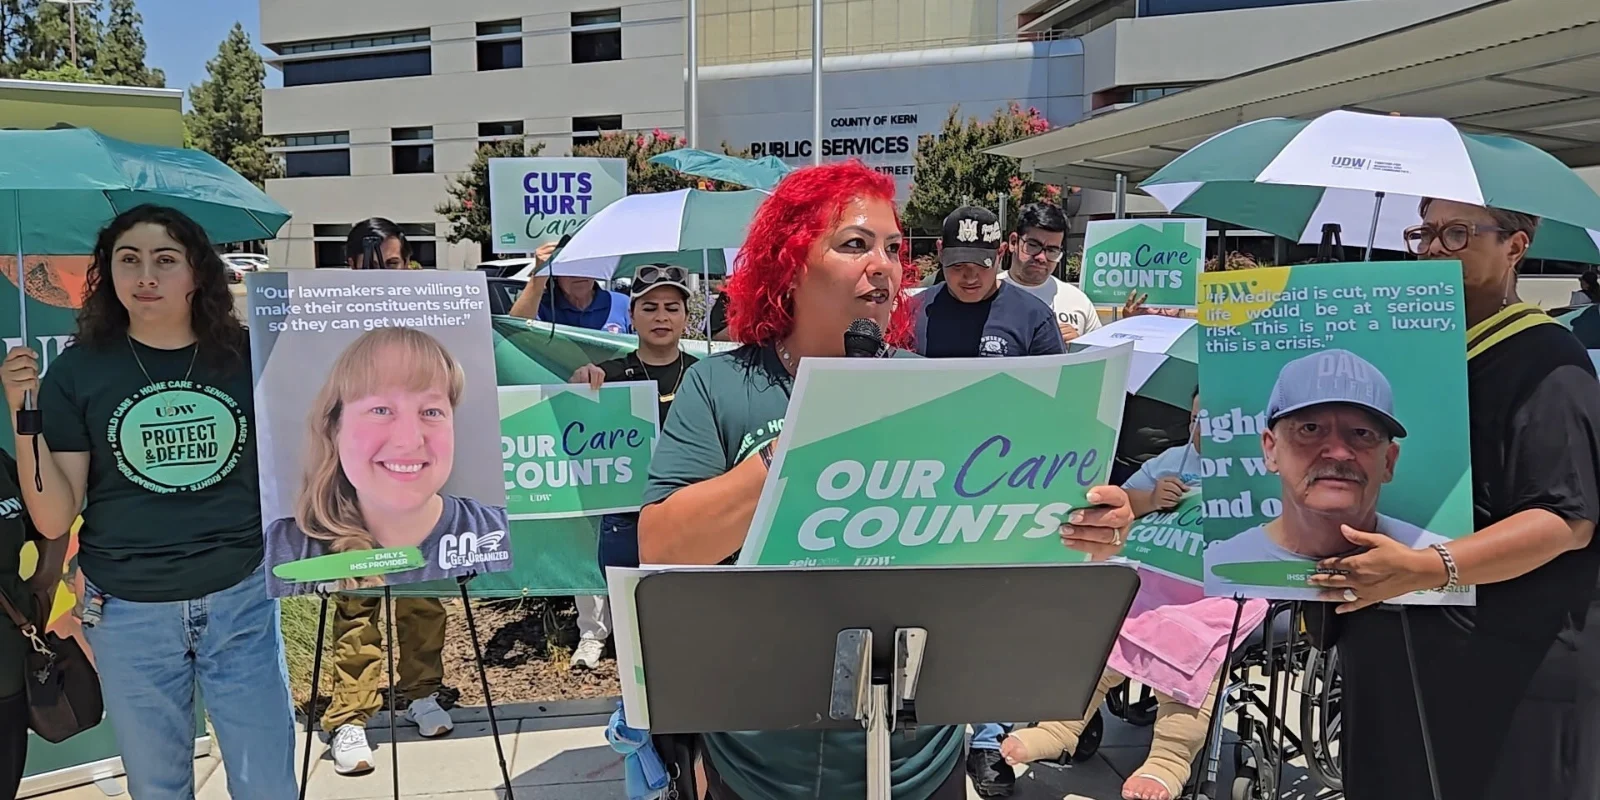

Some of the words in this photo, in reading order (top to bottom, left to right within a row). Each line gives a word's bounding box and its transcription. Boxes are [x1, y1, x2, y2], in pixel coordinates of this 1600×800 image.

[831, 117, 871, 128] COUNTY
[874, 116, 887, 125] OF
[891, 114, 917, 124] KERN
[751, 140, 812, 159] PUBLIC
[822, 136, 909, 156] SERVICES
[874, 166, 915, 176] STREET
[1332, 156, 1366, 167] UDW
[523, 172, 592, 194] CUTS
[524, 195, 592, 215] HURT
[1094, 252, 1132, 267] OUR
[1136, 244, 1192, 267] Care
[1092, 269, 1182, 289] COUNTS
[256, 286, 295, 299] “Our
[298, 284, 384, 298] lawmakers
[388, 287, 411, 296] are
[414, 283, 462, 297] willing
[465, 284, 480, 295] to
[1230, 287, 1308, 304] Medicaid
[1314, 286, 1328, 299] is
[1332, 286, 1367, 300] cut,
[1372, 286, 1401, 299] my
[256, 302, 301, 316] make
[304, 301, 342, 314] their
[346, 299, 440, 312] constituents
[443, 298, 484, 310] suffer
[1206, 308, 1231, 321] life
[1246, 304, 1300, 318] would
[1316, 303, 1338, 315] be
[1354, 302, 1372, 314] at
[1388, 298, 1455, 313] serious
[269, 322, 288, 332] so
[291, 318, 327, 332] they
[331, 319, 359, 329] can
[363, 317, 389, 331] get
[1206, 326, 1240, 336] risk.
[1252, 320, 1288, 334] This
[1300, 319, 1313, 332] is
[1326, 318, 1356, 331] not
[1368, 320, 1379, 330] a
[1392, 316, 1456, 330] luxury,
[1206, 339, 1238, 352] this
[1242, 338, 1256, 351] is
[1261, 340, 1270, 351] a
[1318, 354, 1368, 383] DAD
[140, 381, 168, 396] HOME
[168, 380, 194, 389] CARE
[204, 386, 238, 408] SENIORS
[107, 419, 119, 444] CHILD
[113, 398, 134, 418] CARE
[238, 416, 247, 444] WAGES
[142, 423, 216, 447] PROTECT
[562, 421, 645, 456] Care
[221, 452, 241, 477] LABOR
[816, 459, 946, 501] OUR
[954, 435, 1102, 498] Care
[191, 474, 221, 492] RIGHTS
[530, 494, 552, 502] UDW
[797, 502, 1073, 552] COUNTS
[1142, 512, 1180, 525] OUR
[438, 531, 477, 570] GO
[1127, 525, 1203, 556] COUNT
[350, 562, 368, 570] IHSS
[369, 558, 408, 568] PROVIDER
[375, 552, 398, 560] EMILY
[450, 553, 466, 566] GET
[854, 556, 896, 566] UDW
[1287, 573, 1305, 581] IHSS
